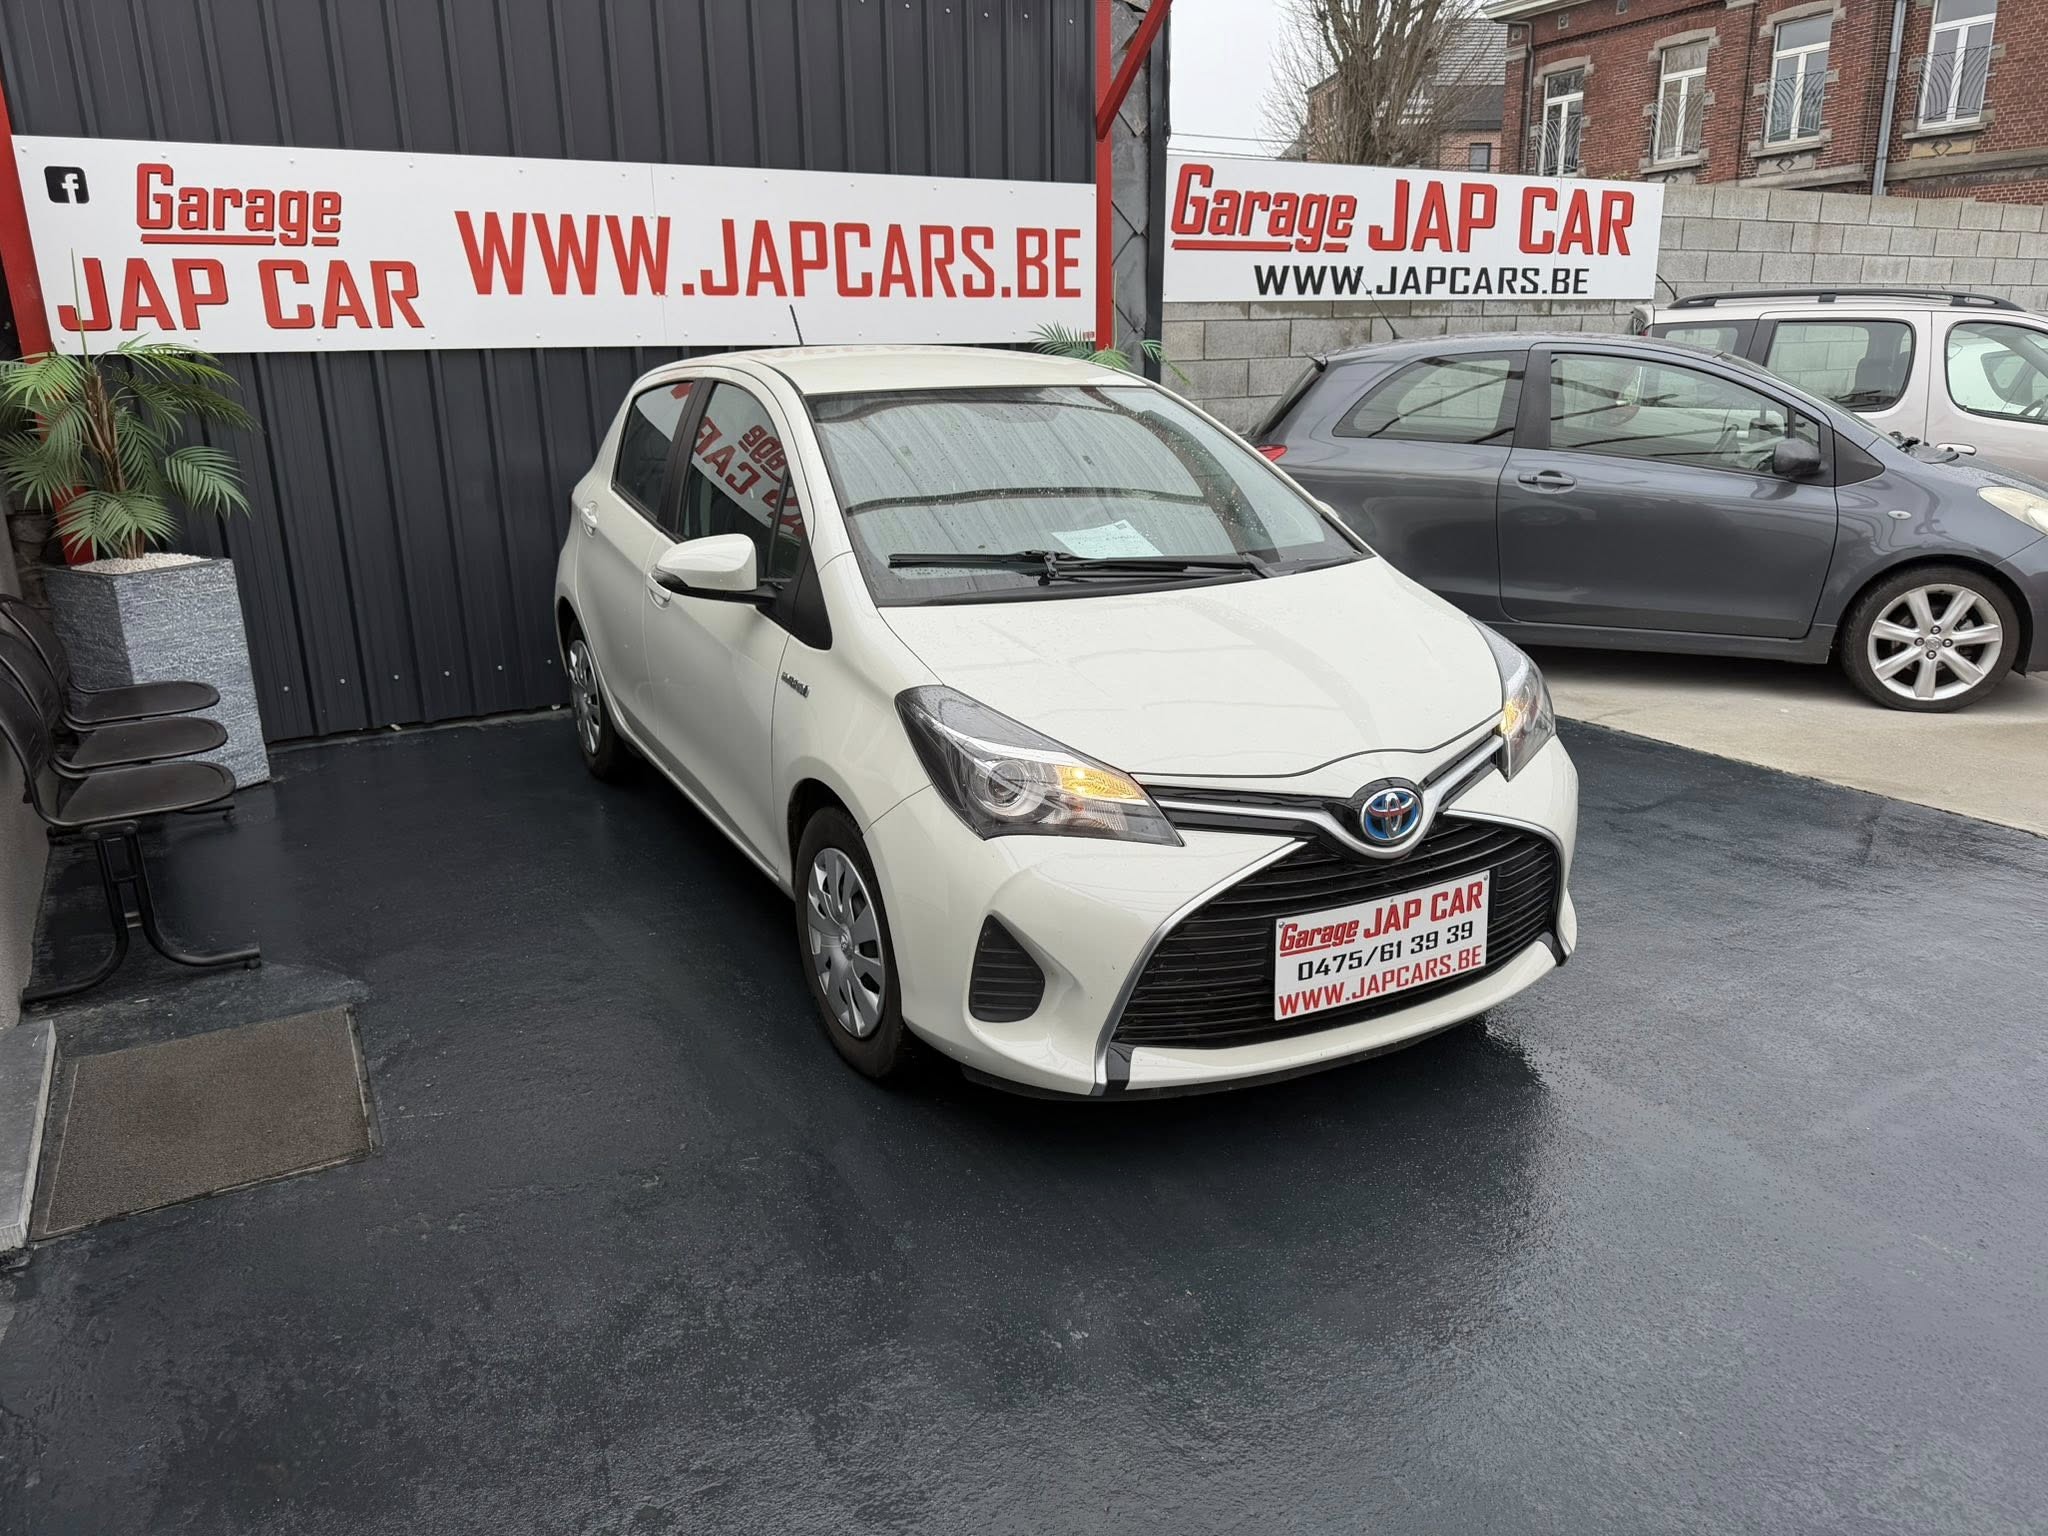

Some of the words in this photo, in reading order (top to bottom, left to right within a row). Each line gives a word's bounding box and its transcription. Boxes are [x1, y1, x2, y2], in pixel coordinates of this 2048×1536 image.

[137, 163, 342, 246] Garage
[1171, 163, 1358, 253] Garage
[1368, 179, 1498, 253] JAP
[1519, 186, 1635, 256] CAR
[455, 210, 1081, 298] WWW.JAPCARS.BE
[1254, 265, 1589, 296] WWW.JAPCARS.BE
[58, 257, 229, 332] JAP
[258, 259, 425, 329] CAR
[1280, 919, 1360, 957] Garage
[1364, 898, 1422, 939] JAP
[1430, 881, 1483, 922] CAR
[1297, 940, 1402, 981] 0475/61
[1410, 931, 1439, 955] 39
[1446, 920, 1473, 944] 39
[1278, 945, 1483, 1016] WWW.JAPCARS.BE
